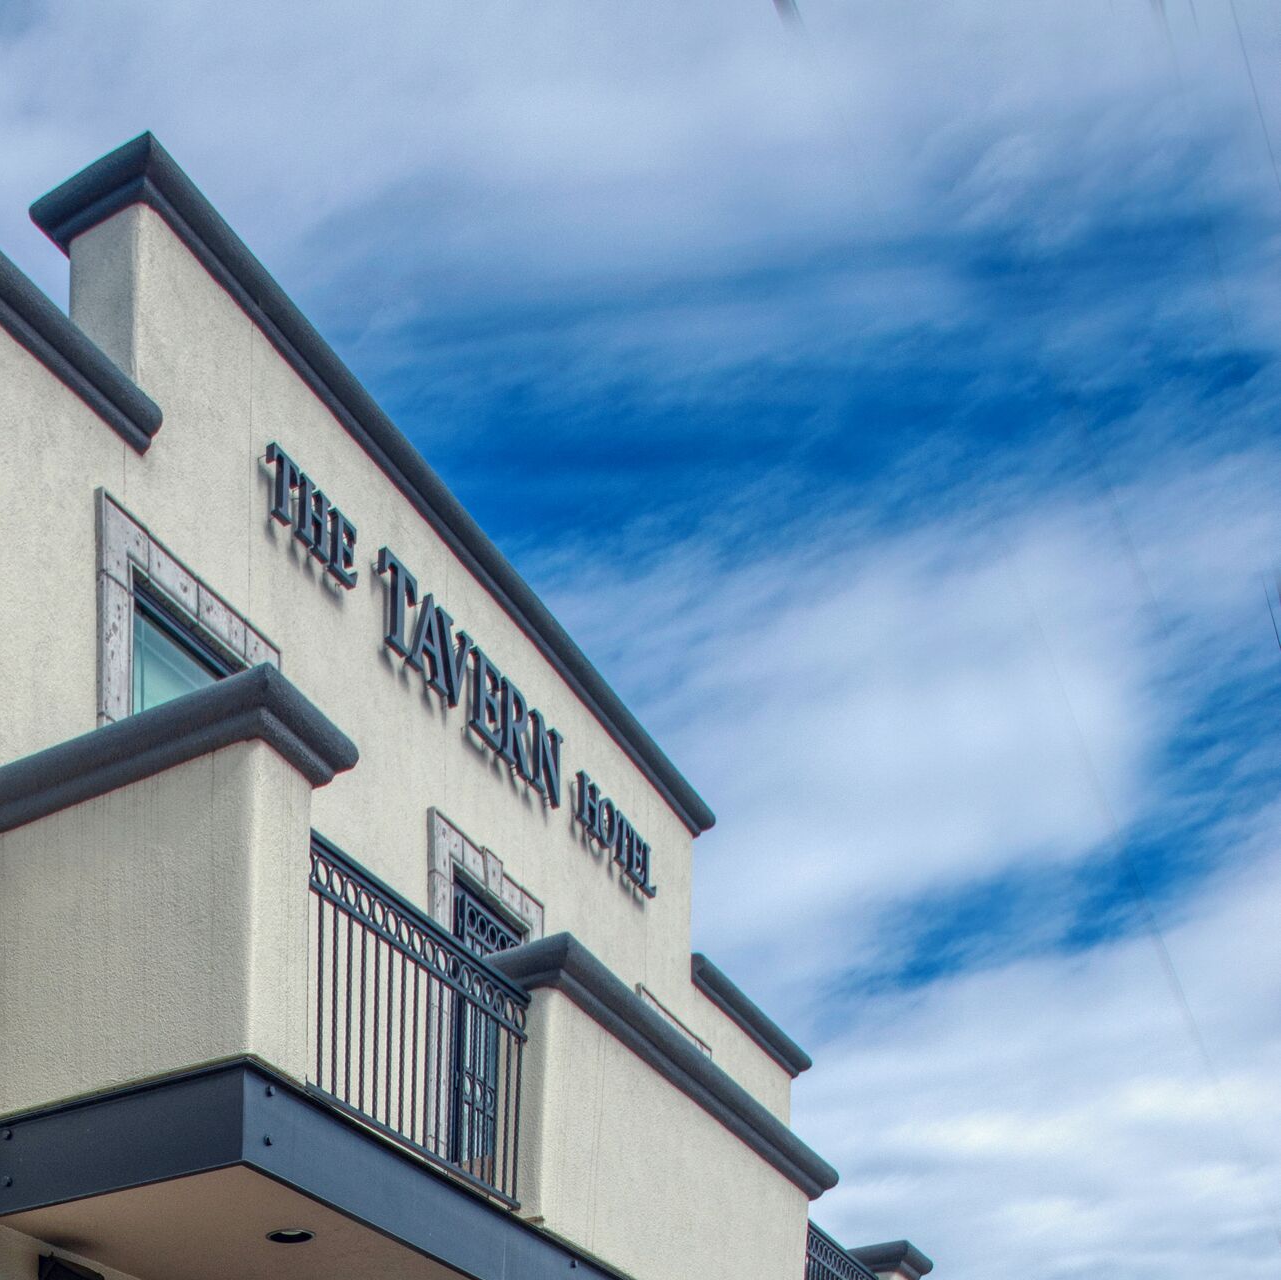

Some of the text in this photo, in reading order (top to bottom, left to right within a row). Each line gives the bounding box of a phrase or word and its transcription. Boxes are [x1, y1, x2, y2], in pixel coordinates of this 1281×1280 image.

[265, 441, 657, 900] THE TAVERN HOTEL
